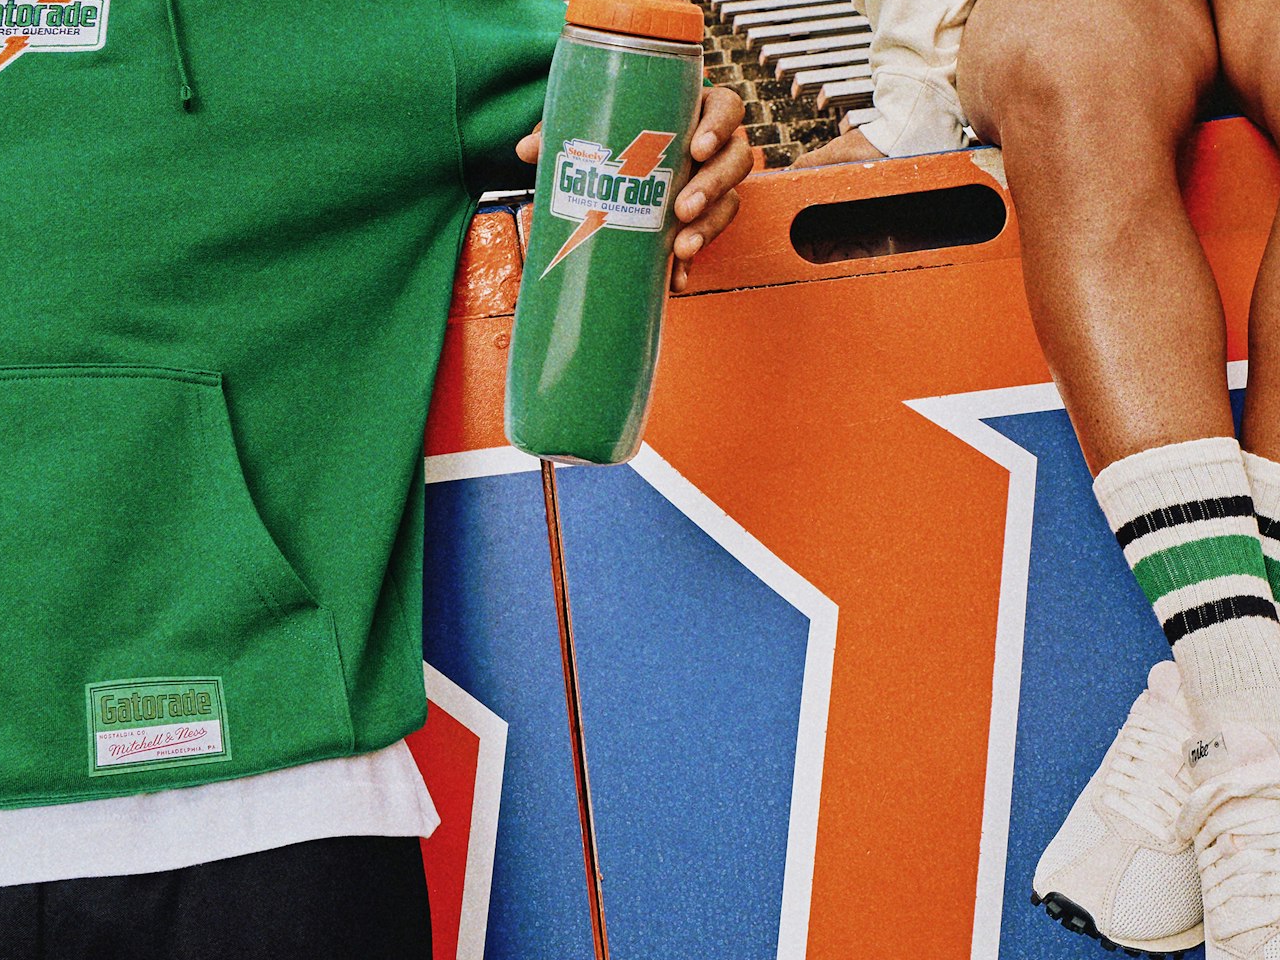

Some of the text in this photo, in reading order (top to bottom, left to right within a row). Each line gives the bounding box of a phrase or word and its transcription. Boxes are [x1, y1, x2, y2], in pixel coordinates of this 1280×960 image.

[22, 27, 81, 36] QUENCHER
[559, 160, 666, 207] Gatorade
[567, 195, 651, 215] THIRST QUENCHER
[101, 689, 212, 725] Gatorade
[109, 727, 208, 757] Mitchell & Ness
